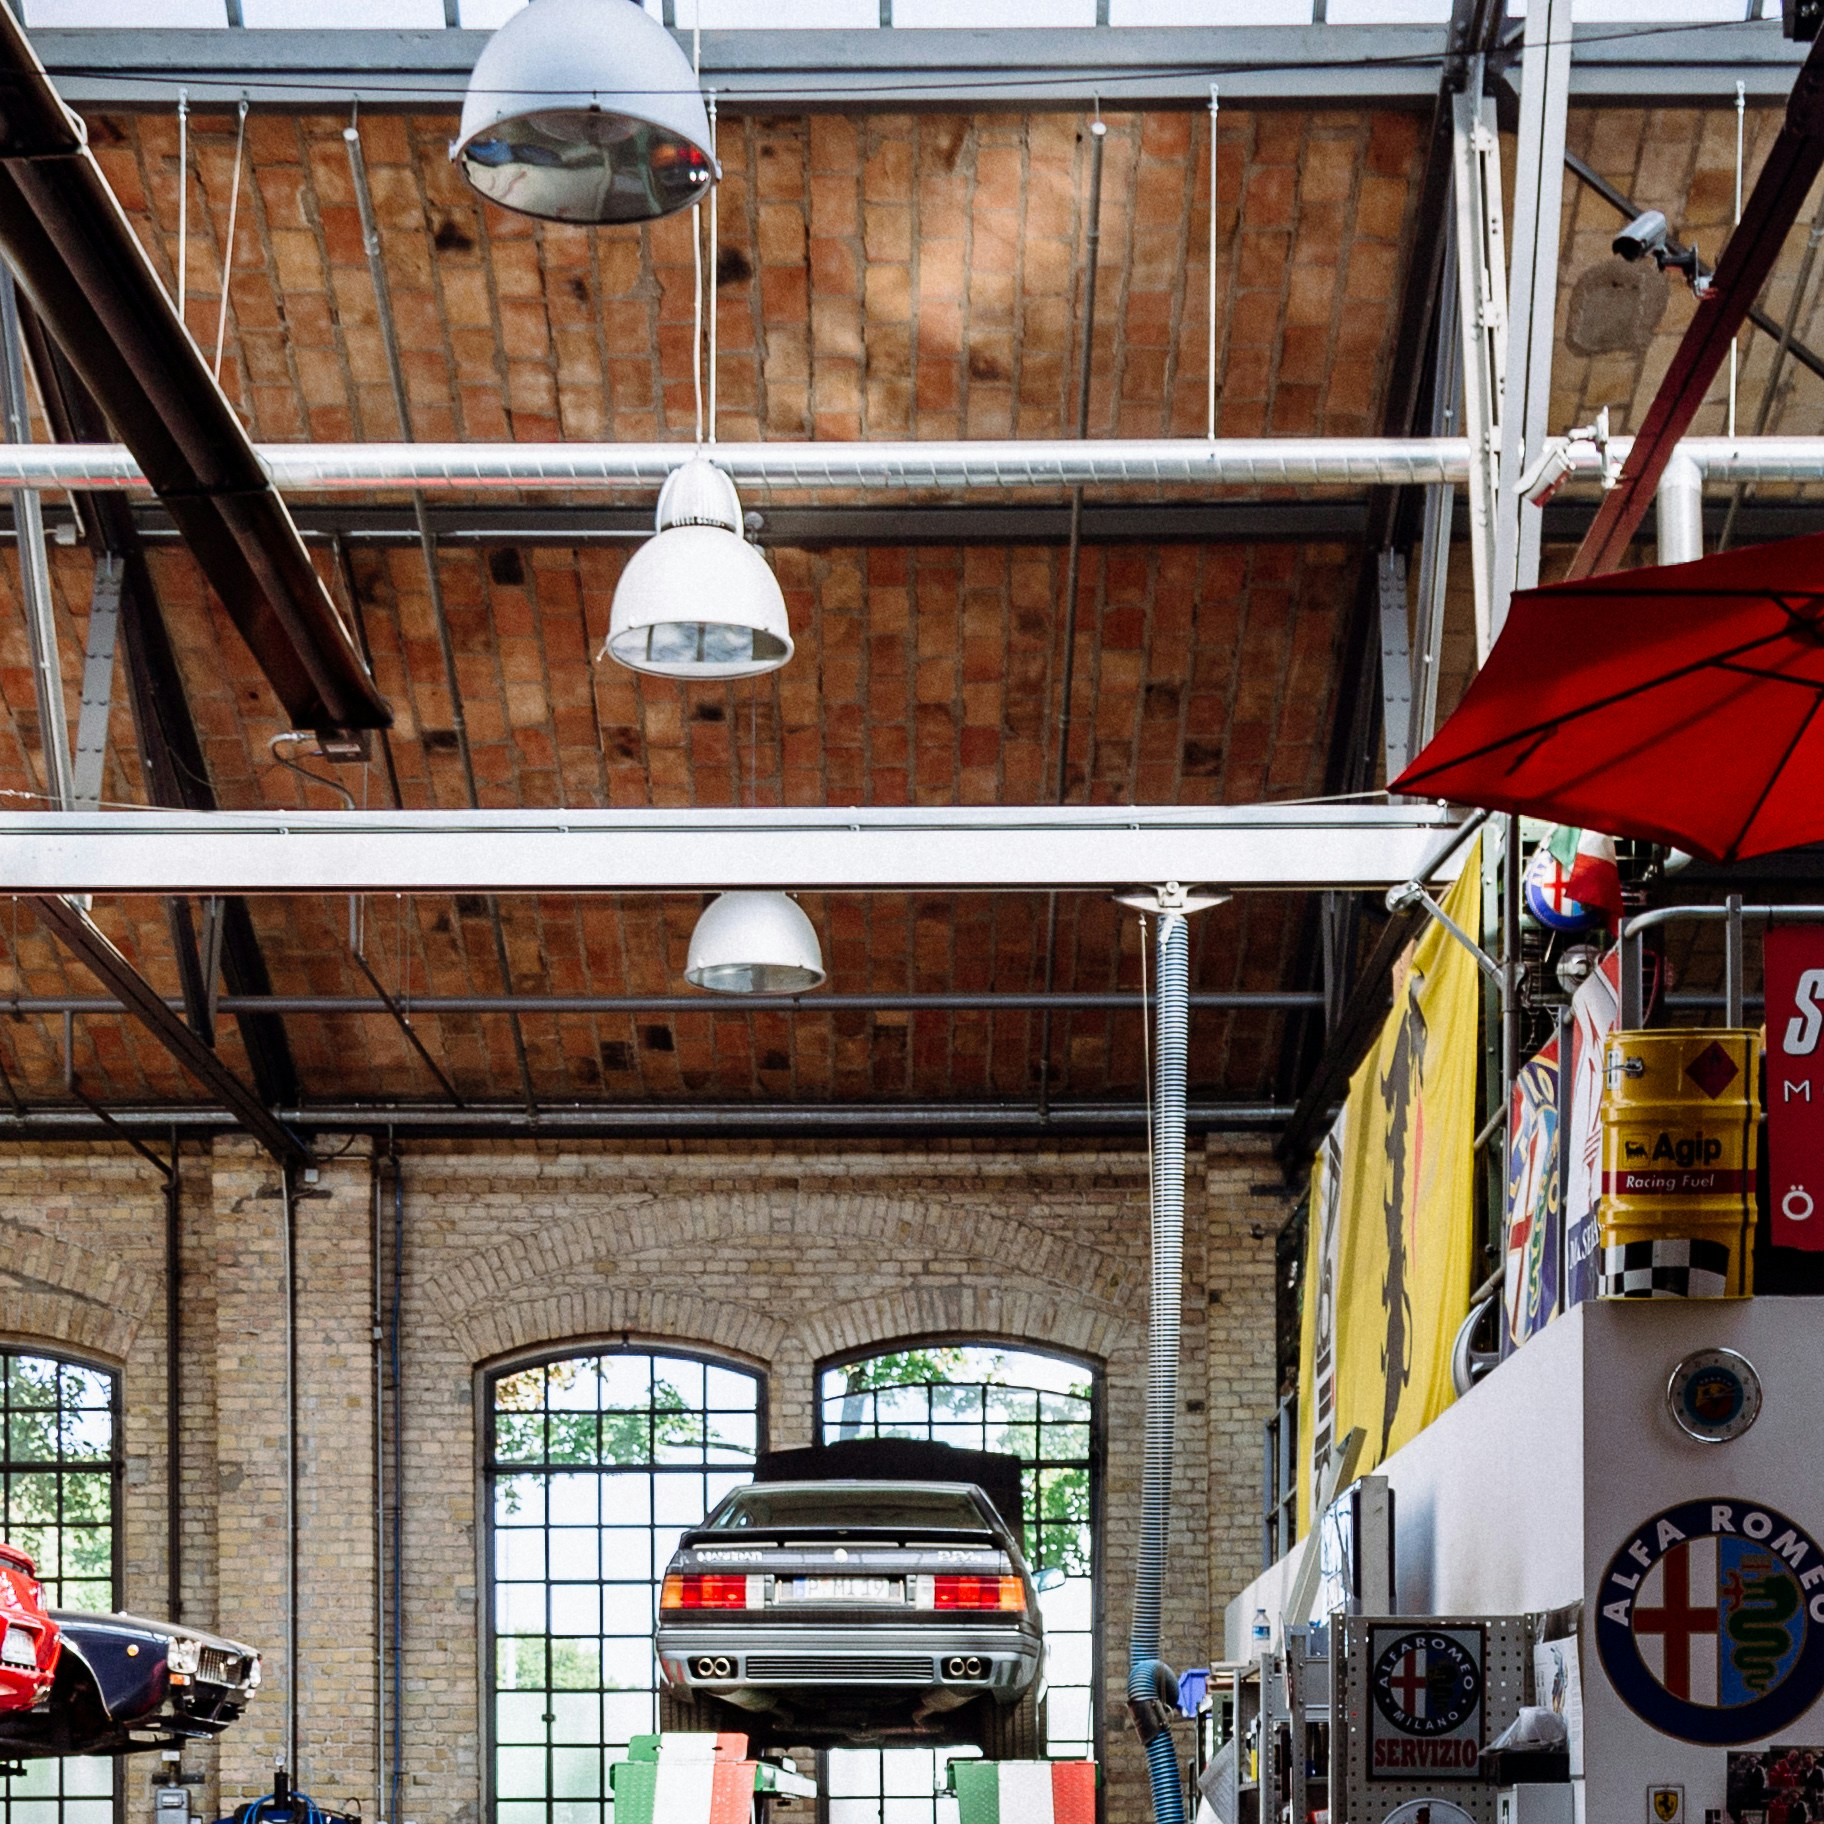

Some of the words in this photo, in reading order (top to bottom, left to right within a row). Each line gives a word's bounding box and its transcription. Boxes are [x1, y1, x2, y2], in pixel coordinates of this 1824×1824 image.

[1652, 1131, 1723, 1168] Agip
[1626, 1175, 1676, 1192] Racing
[1682, 1174, 1715, 1188] Fuel
[1603, 1518, 1686, 1627] ALFA
[1393, 1711, 1459, 1730] MILANO
[1375, 1738, 1478, 1768] SERVIZIO
